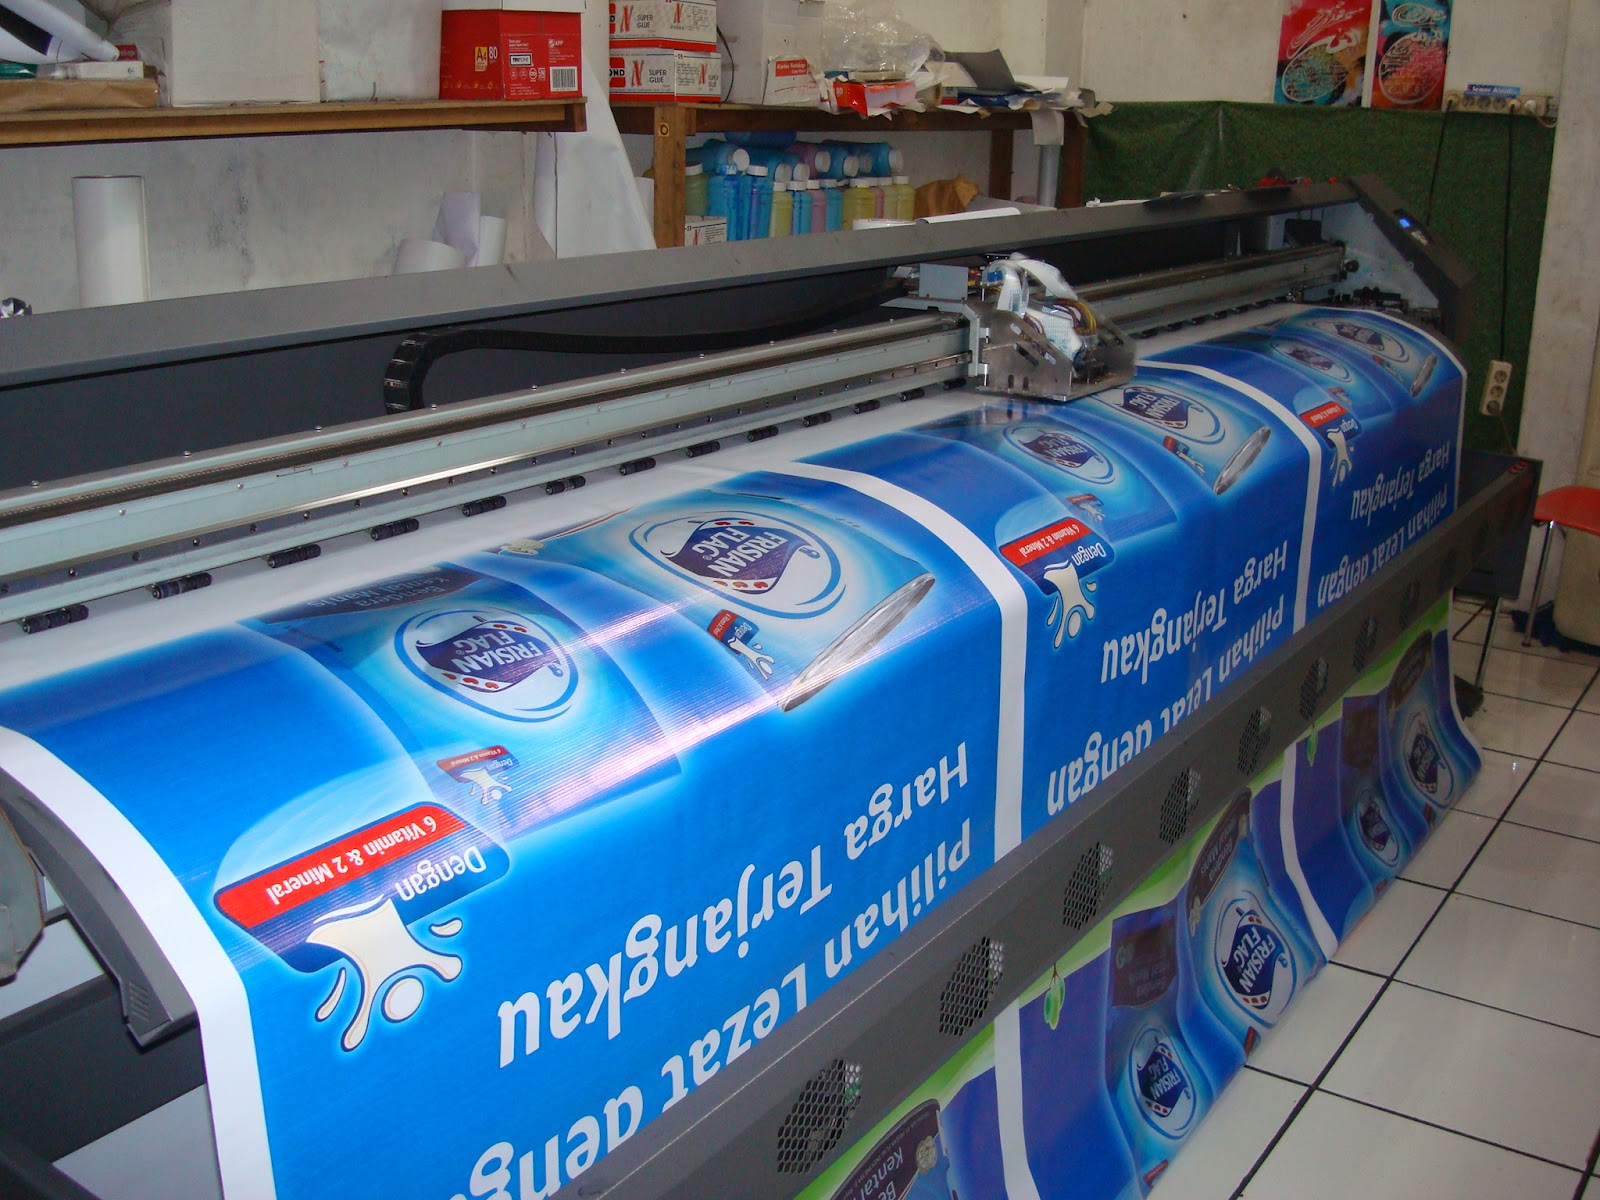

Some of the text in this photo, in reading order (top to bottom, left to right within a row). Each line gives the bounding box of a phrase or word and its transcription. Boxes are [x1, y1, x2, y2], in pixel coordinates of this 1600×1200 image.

[637, 21, 650, 29] GLUE
[488, 46, 498, 60] 80
[1351, 441, 1450, 526] Harga Terjangkau
[1408, 483, 1448, 540] Pilihan
[708, 531, 788, 578] FRISIAN
[1019, 524, 1080, 558] 6 Vitamin & 2 Mineral
[1071, 542, 1107, 566] Dengan
[1370, 526, 1405, 574] Lezat
[1102, 540, 1288, 685] Harga Terjangkau
[1219, 595, 1284, 684] Pilihan
[451, 641, 544, 673] FRISIAN
[486, 758, 513, 770] Dengan
[266, 816, 437, 905] 6 Vitamin & 2 Mineral
[394, 846, 487, 901] Dengan
[498, 742, 967, 1069] Harga Terjangkau
[825, 818, 970, 978] Pilihan
[1233, 926, 1261, 968] FLAG
[1239, 934, 1277, 993] FRISIAN
[662, 963, 807, 1113] Lezat
[1149, 1069, 1181, 1100] FRISIAN
[861, 1146, 904, 1200] Kental
